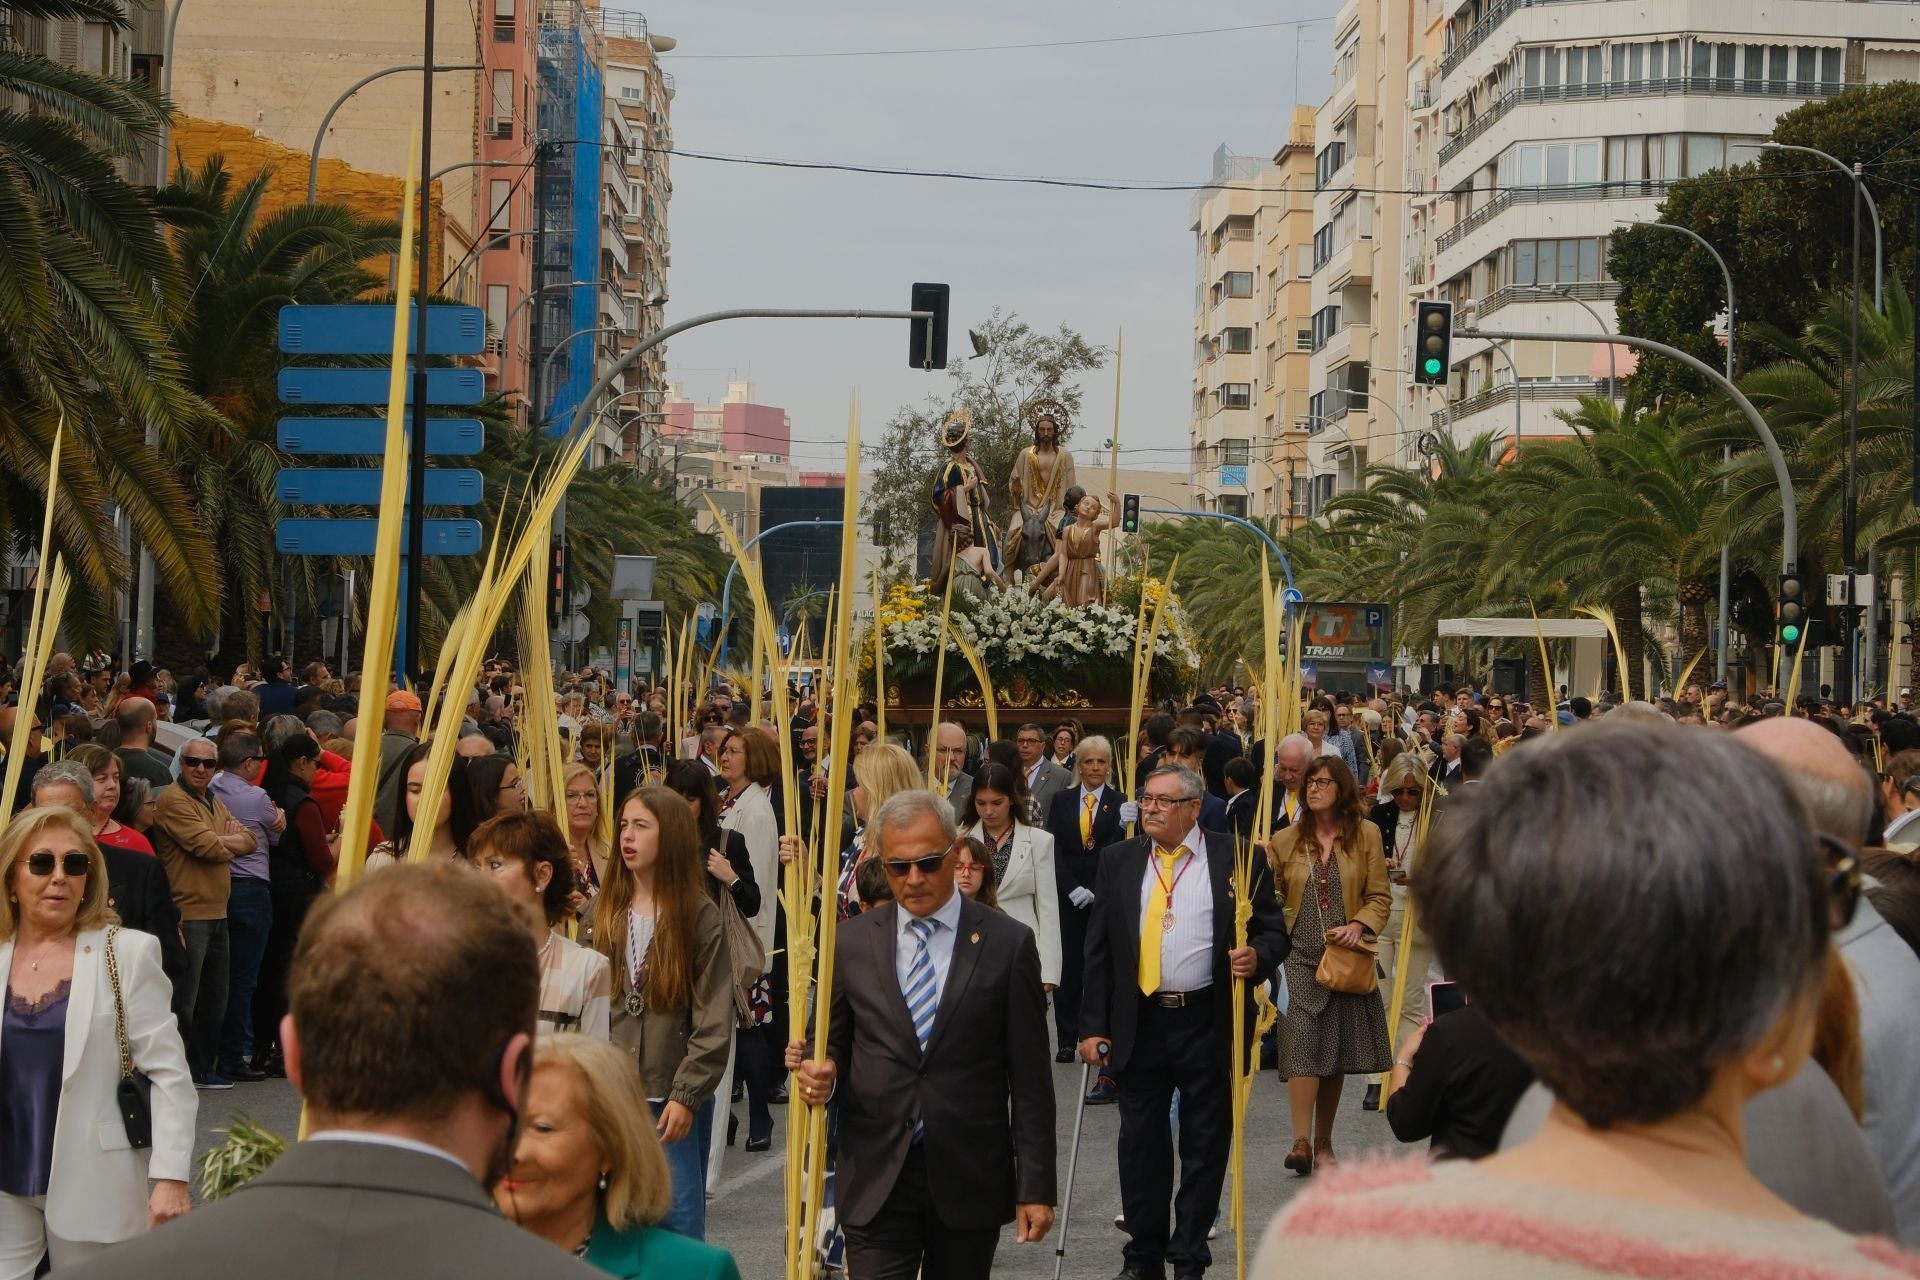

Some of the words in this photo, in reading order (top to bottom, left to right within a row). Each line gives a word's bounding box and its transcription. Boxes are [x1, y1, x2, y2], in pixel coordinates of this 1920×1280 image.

[1369, 611, 1380, 624] P
[621, 621, 627, 630] 6
[1305, 645, 1345, 656] TRAM
